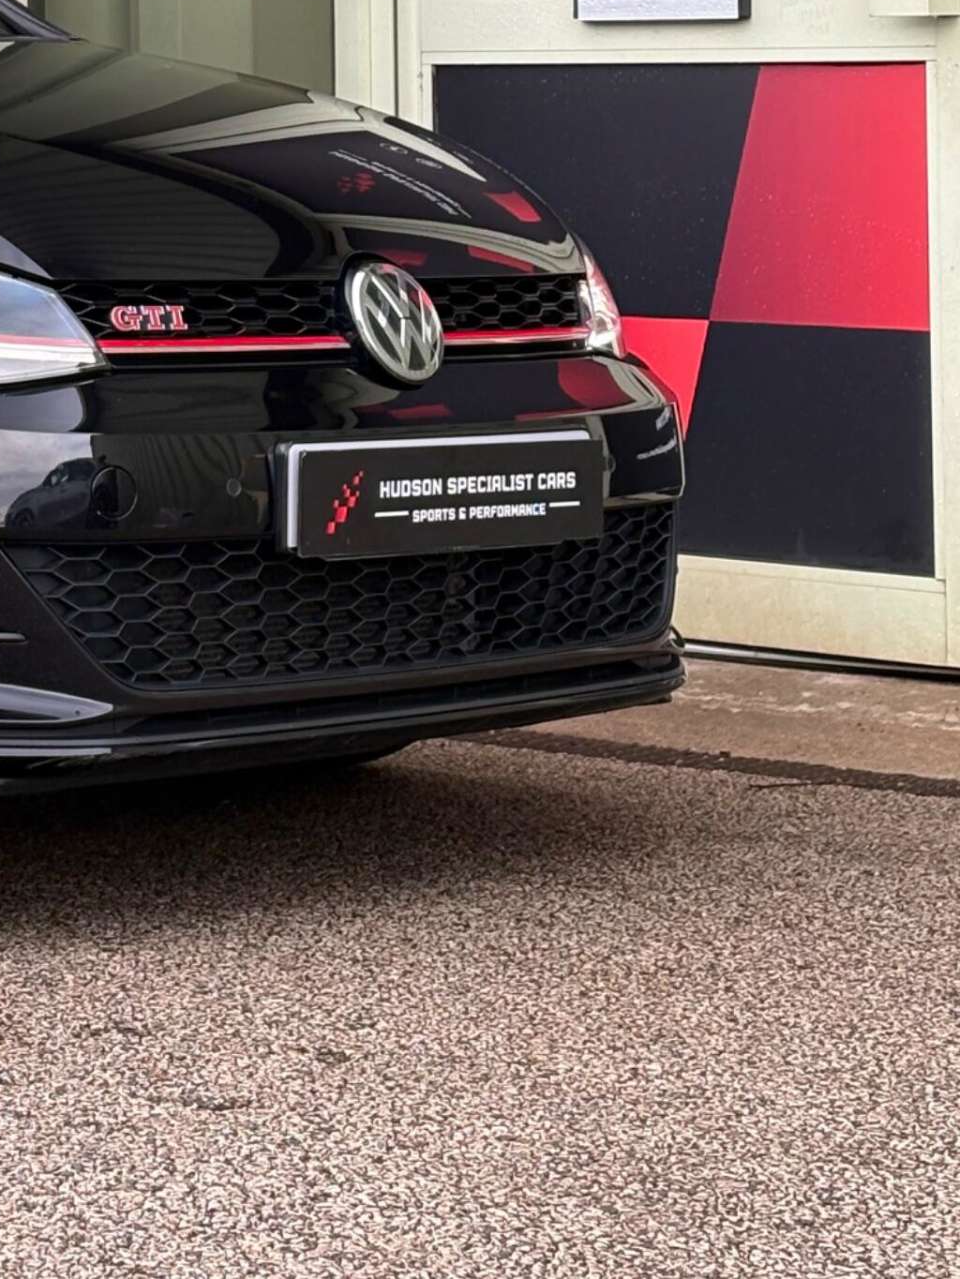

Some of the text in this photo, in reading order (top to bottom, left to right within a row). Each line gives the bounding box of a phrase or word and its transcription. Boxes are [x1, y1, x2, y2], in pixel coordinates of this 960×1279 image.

[110, 305, 189, 331] GTI
[379, 471, 577, 499] HUDSON SPECIALIST CARS
[412, 502, 547, 523] SPORTS & PERFORMANCE
